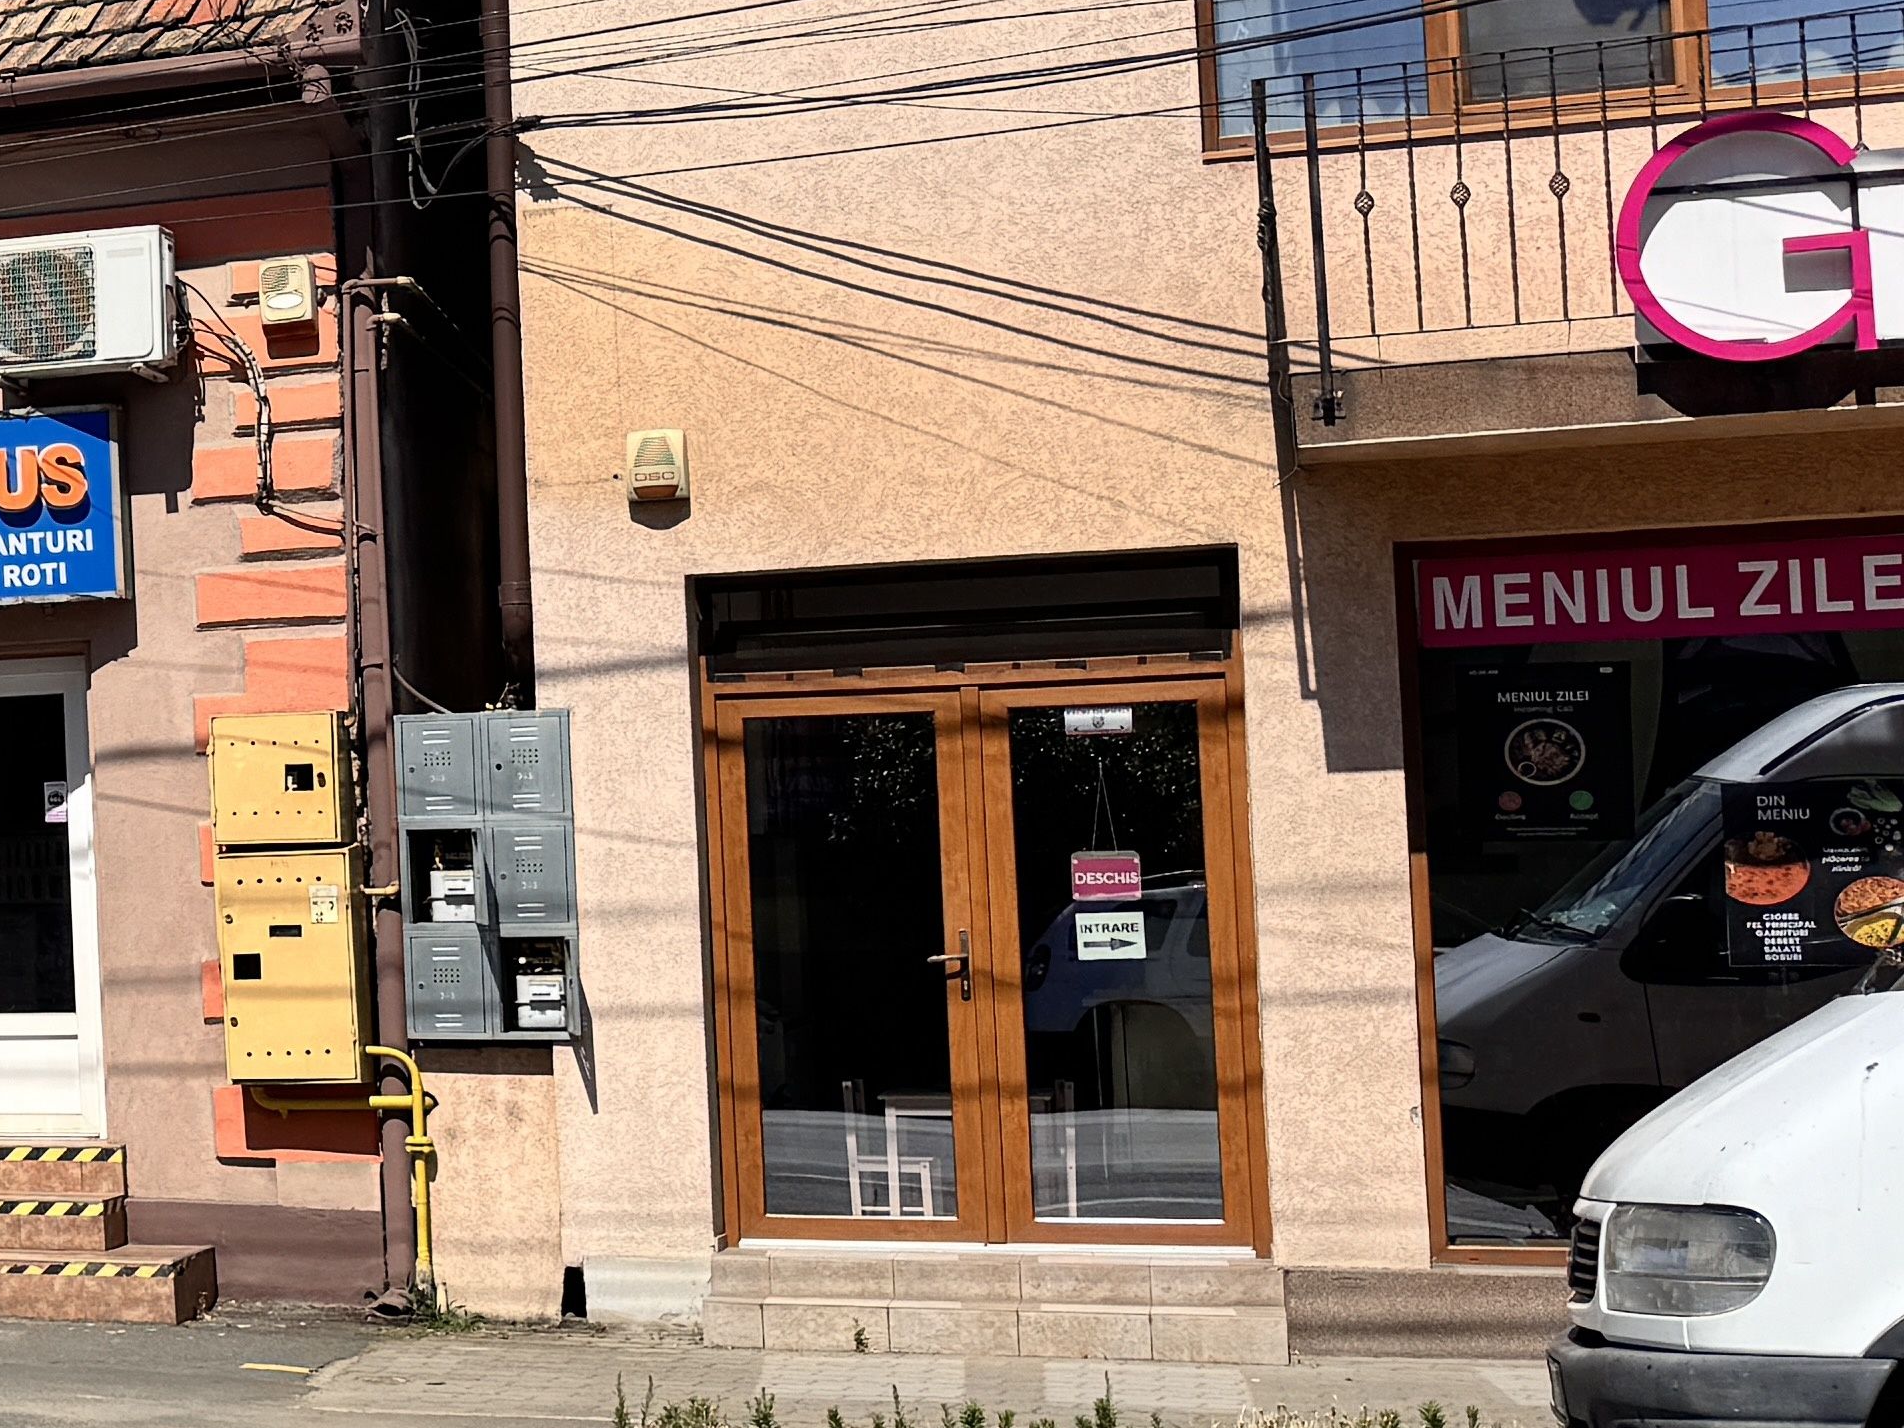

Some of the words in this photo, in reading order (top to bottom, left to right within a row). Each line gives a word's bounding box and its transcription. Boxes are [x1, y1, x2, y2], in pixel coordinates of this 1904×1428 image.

[3, 563, 67, 588] ROTI
[1432, 565, 1714, 631] MENIUL
[1738, 554, 1904, 616] ZILE
[1497, 691, 1552, 703] MENIUL
[1556, 690, 1589, 702] ZILEI
[1757, 795, 1786, 807] DIN
[1757, 808, 1811, 821] MENIU
[1075, 872, 1138, 884] DESCHIS
[1080, 922, 1139, 934] INTRARE
